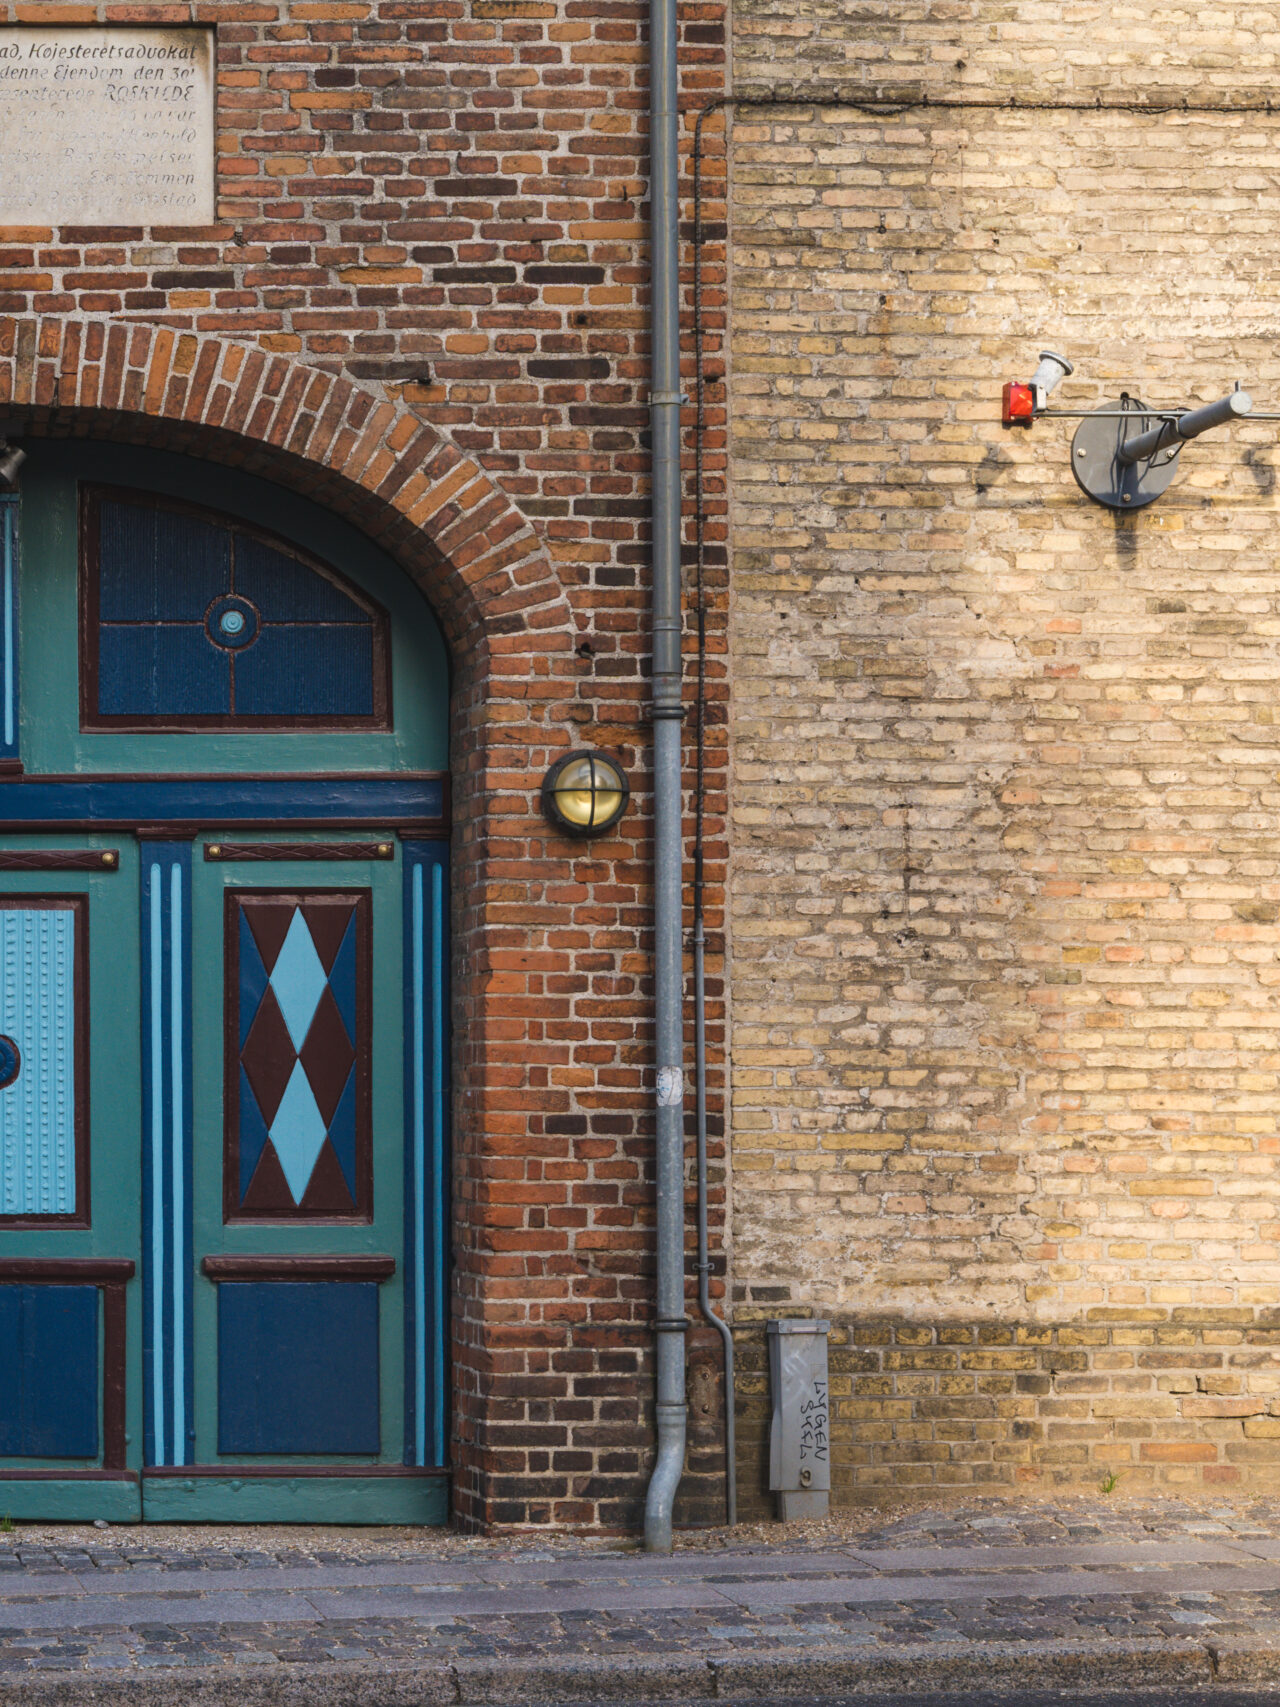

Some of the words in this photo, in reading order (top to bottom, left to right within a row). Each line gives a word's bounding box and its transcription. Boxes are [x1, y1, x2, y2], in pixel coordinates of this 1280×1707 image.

[28, 43, 197, 61] Højesteretsadvokat
[0, 65, 49, 80] denne
[53, 64, 123, 82] Ejendom
[133, 65, 164, 80] den
[104, 84, 195, 102] ROSKILDE
